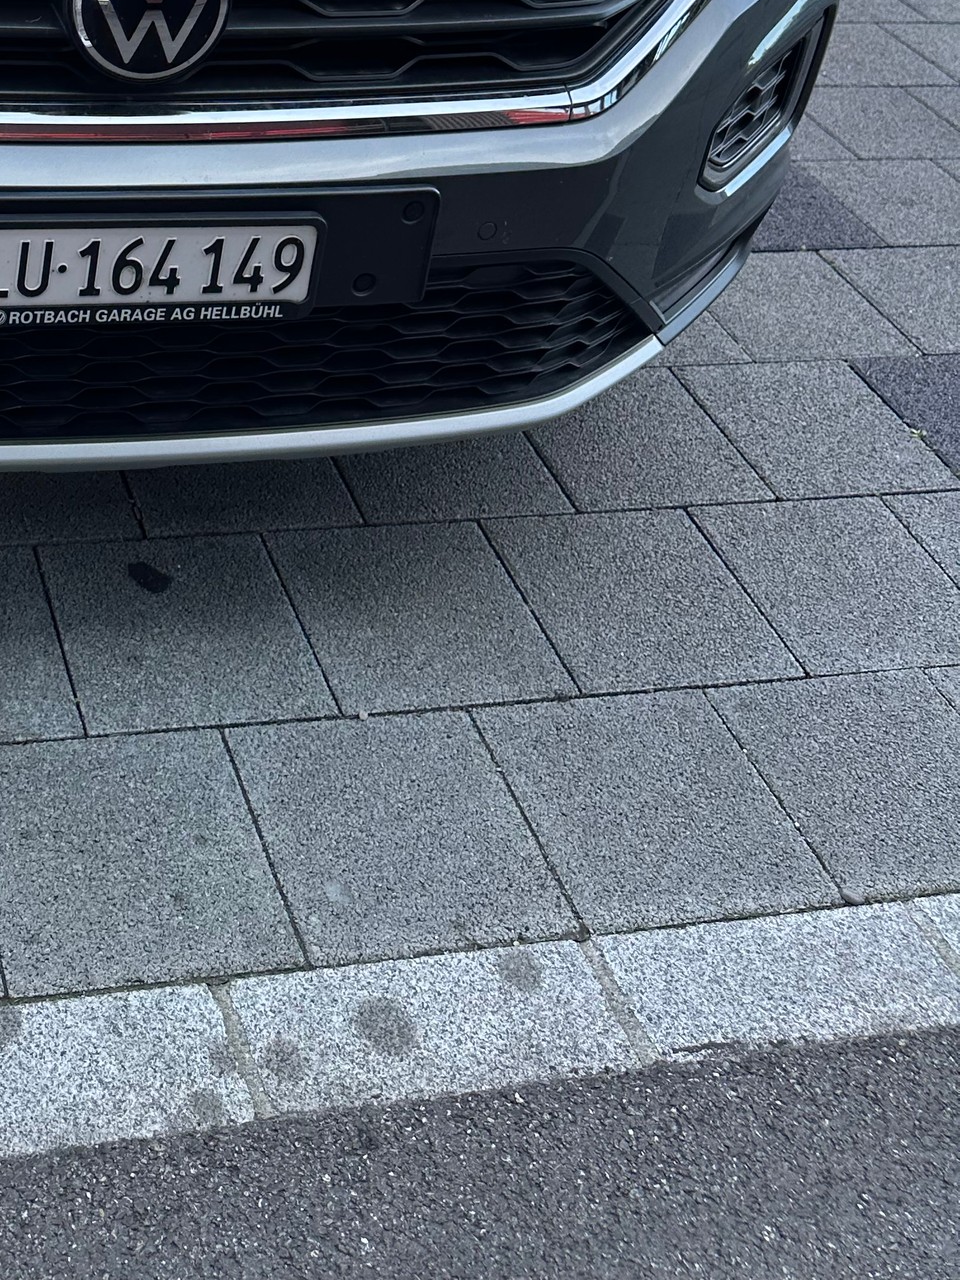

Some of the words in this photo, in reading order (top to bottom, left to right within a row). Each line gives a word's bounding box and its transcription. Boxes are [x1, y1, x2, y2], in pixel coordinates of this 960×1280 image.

[201, 235, 306, 295] 149
[8, 309, 90, 325] ROTBACH
[95, 307, 167, 323] GARAGE
[170, 307, 196, 321] AG
[200, 303, 284, 319] HELLBÜHL
